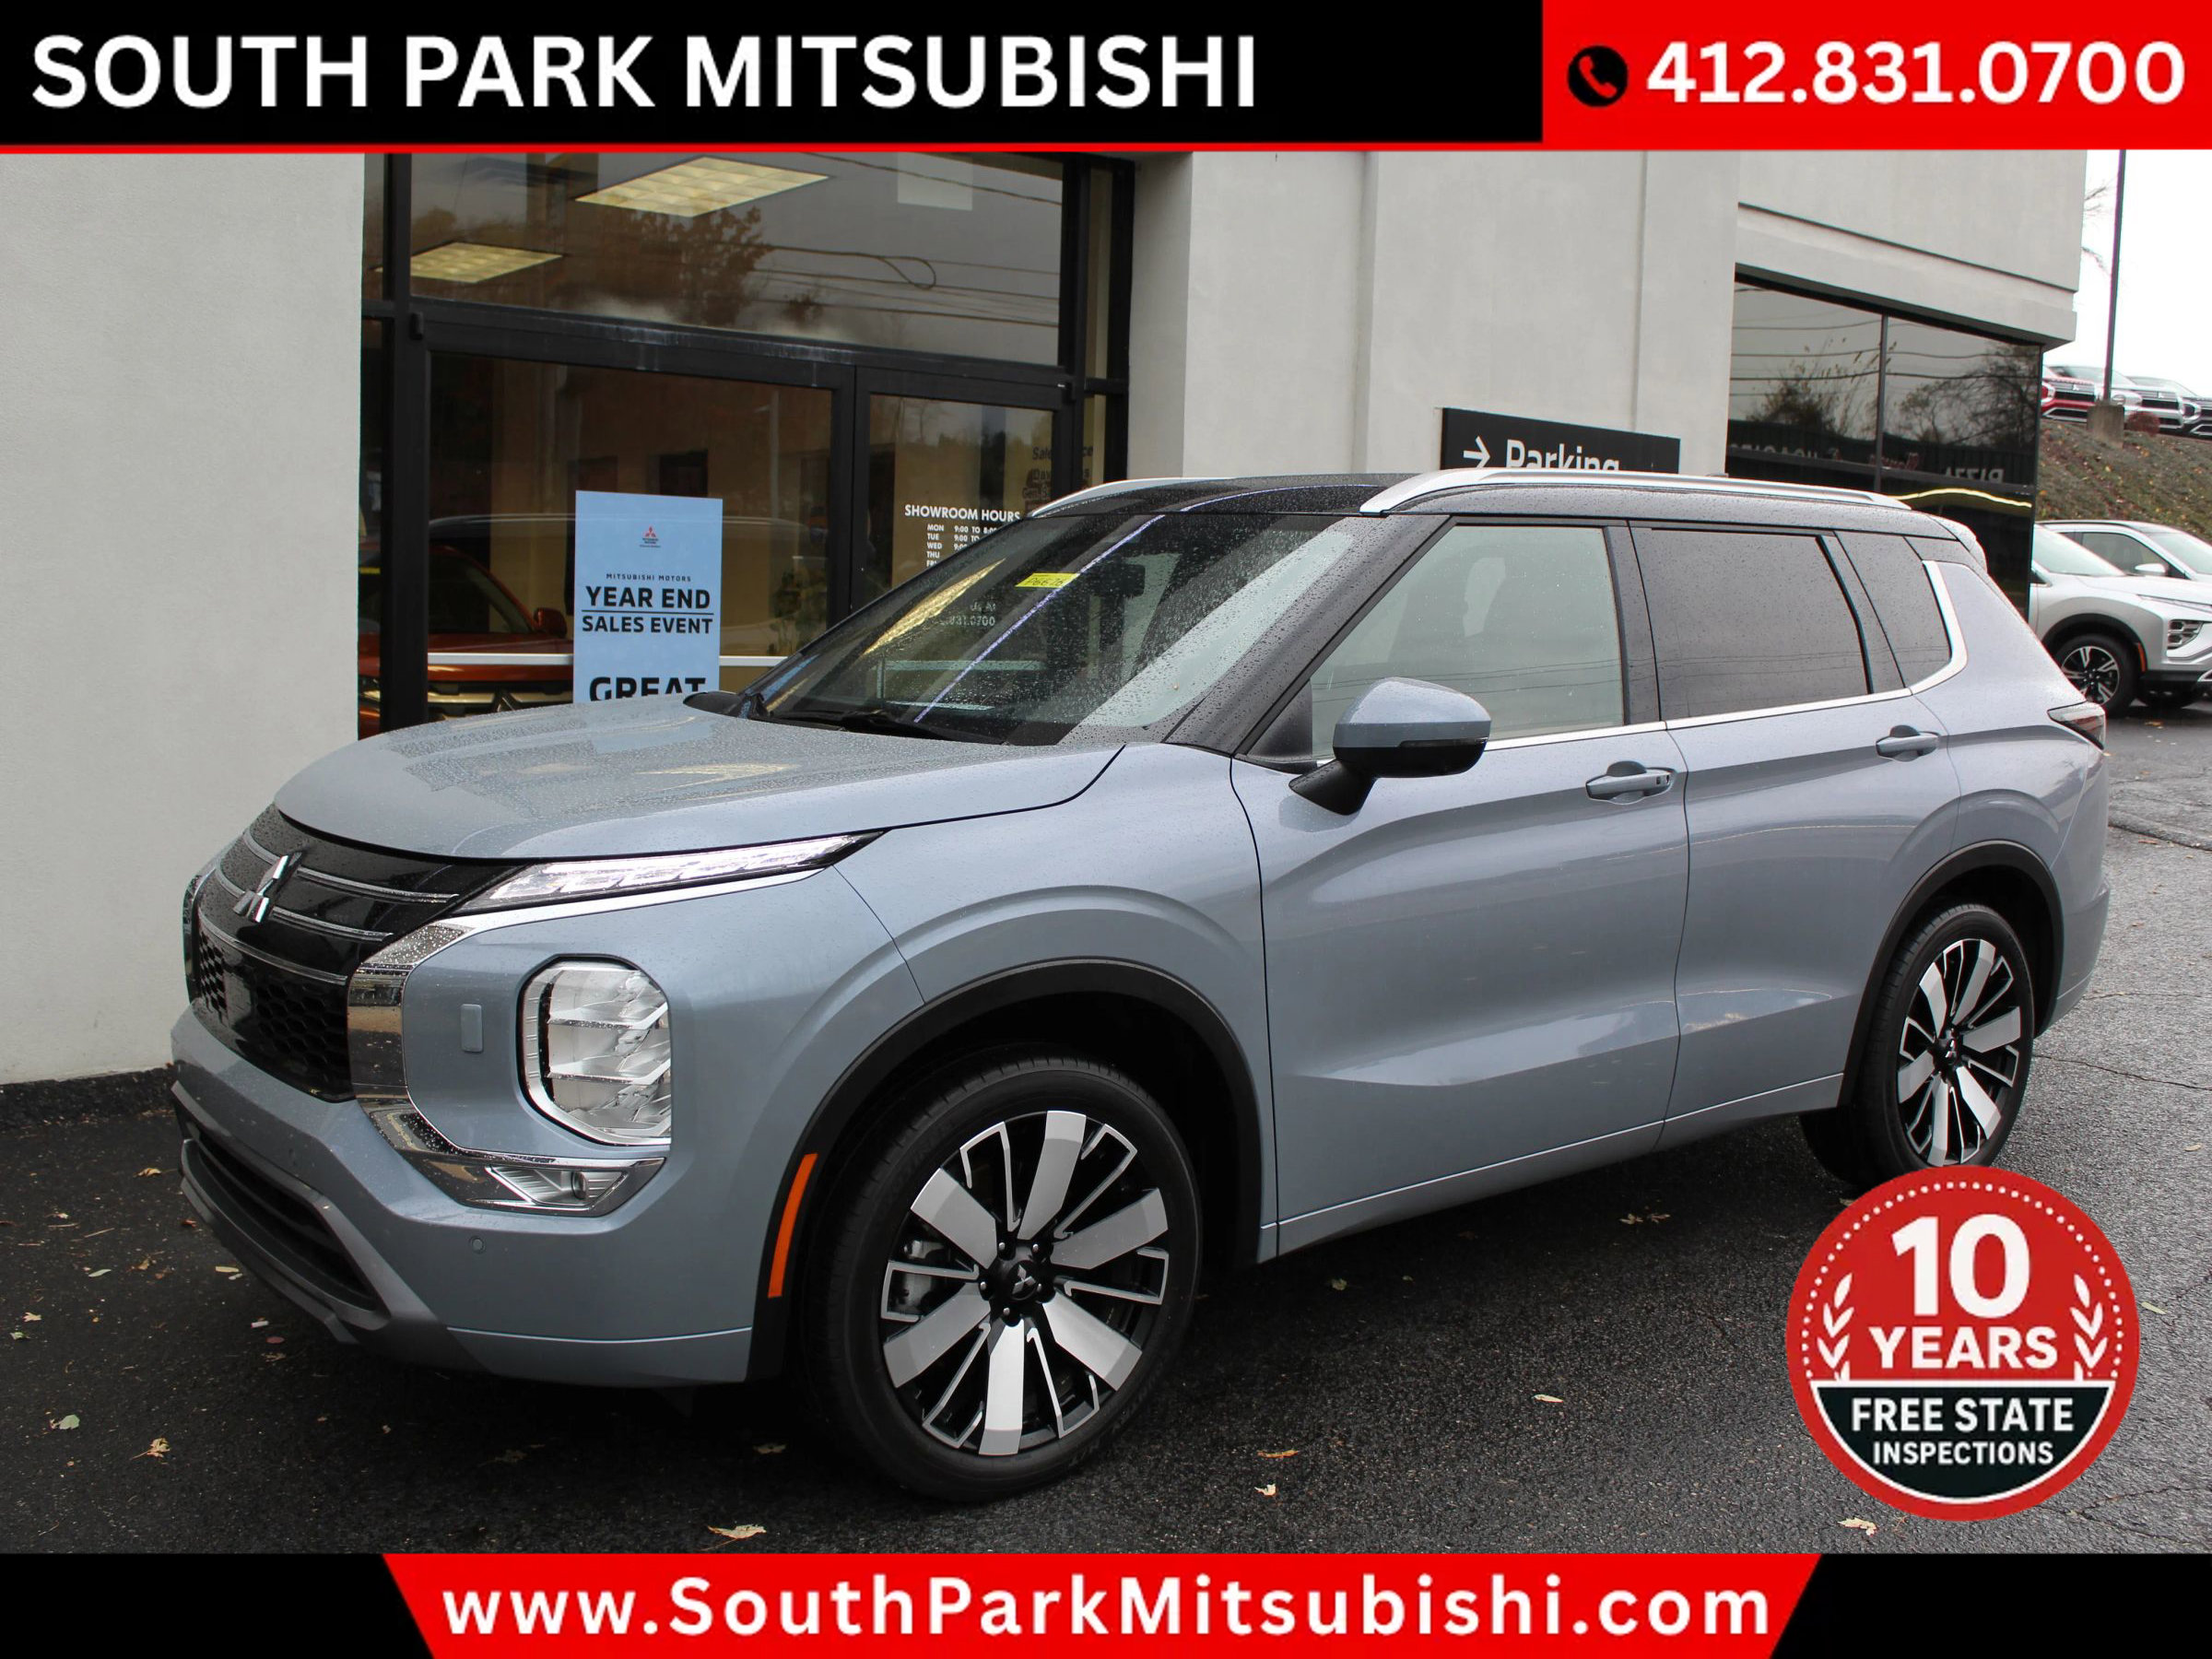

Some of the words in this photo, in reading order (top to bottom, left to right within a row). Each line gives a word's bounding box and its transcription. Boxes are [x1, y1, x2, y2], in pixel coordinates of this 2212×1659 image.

[1506, 439, 1619, 471] Parki
[904, 504, 978, 520] SHOWROOM
[981, 509, 1020, 523] HOURS
[927, 524, 944, 532] MON
[954, 525, 969, 534] 9:00
[953, 534, 968, 542] 9:00
[606, 572, 655, 582] MITSUBISHI
[585, 585, 653, 608] YEAR
[662, 587, 711, 609] END
[582, 616, 644, 633] SALES
[651, 618, 713, 634] EVENT
[589, 677, 707, 701] GREAT
